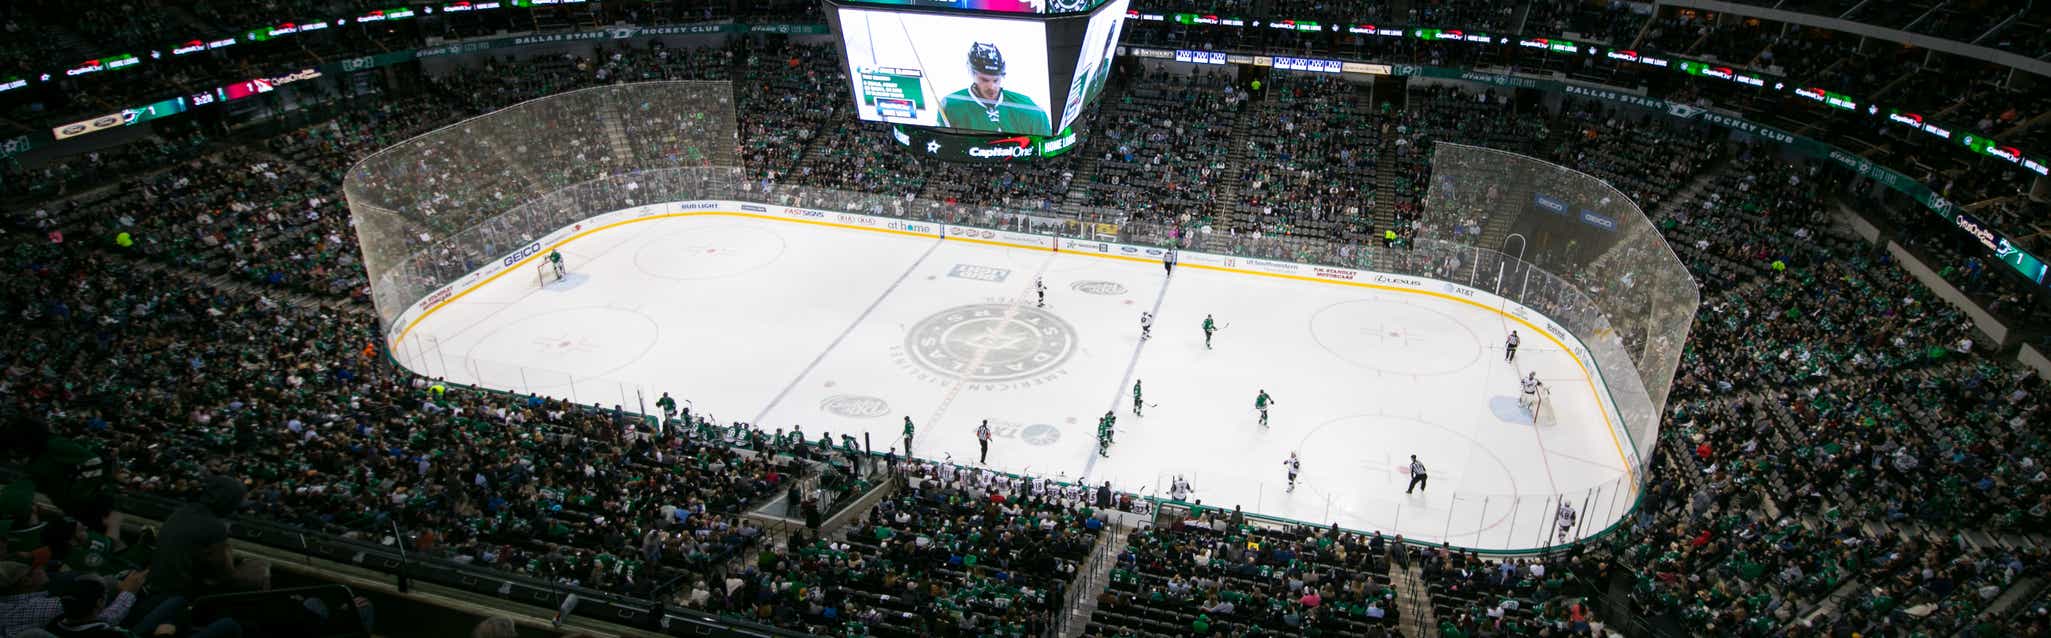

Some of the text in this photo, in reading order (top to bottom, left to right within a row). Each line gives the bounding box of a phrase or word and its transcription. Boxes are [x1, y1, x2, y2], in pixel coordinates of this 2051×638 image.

[515, 34, 561, 44] DALLAS
[566, 31, 604, 40] STARS
[642, 26, 687, 35] HOCKEY
[1566, 86, 1794, 144] DALLAS STARS HOCKEY CLUB
[1045, 139, 1063, 154] HOME
[503, 242, 541, 267] GEICO
[2016, 253, 2024, 265] 1
[1387, 278, 1421, 287] LEXUS
[1456, 287, 1474, 297] AT&T
